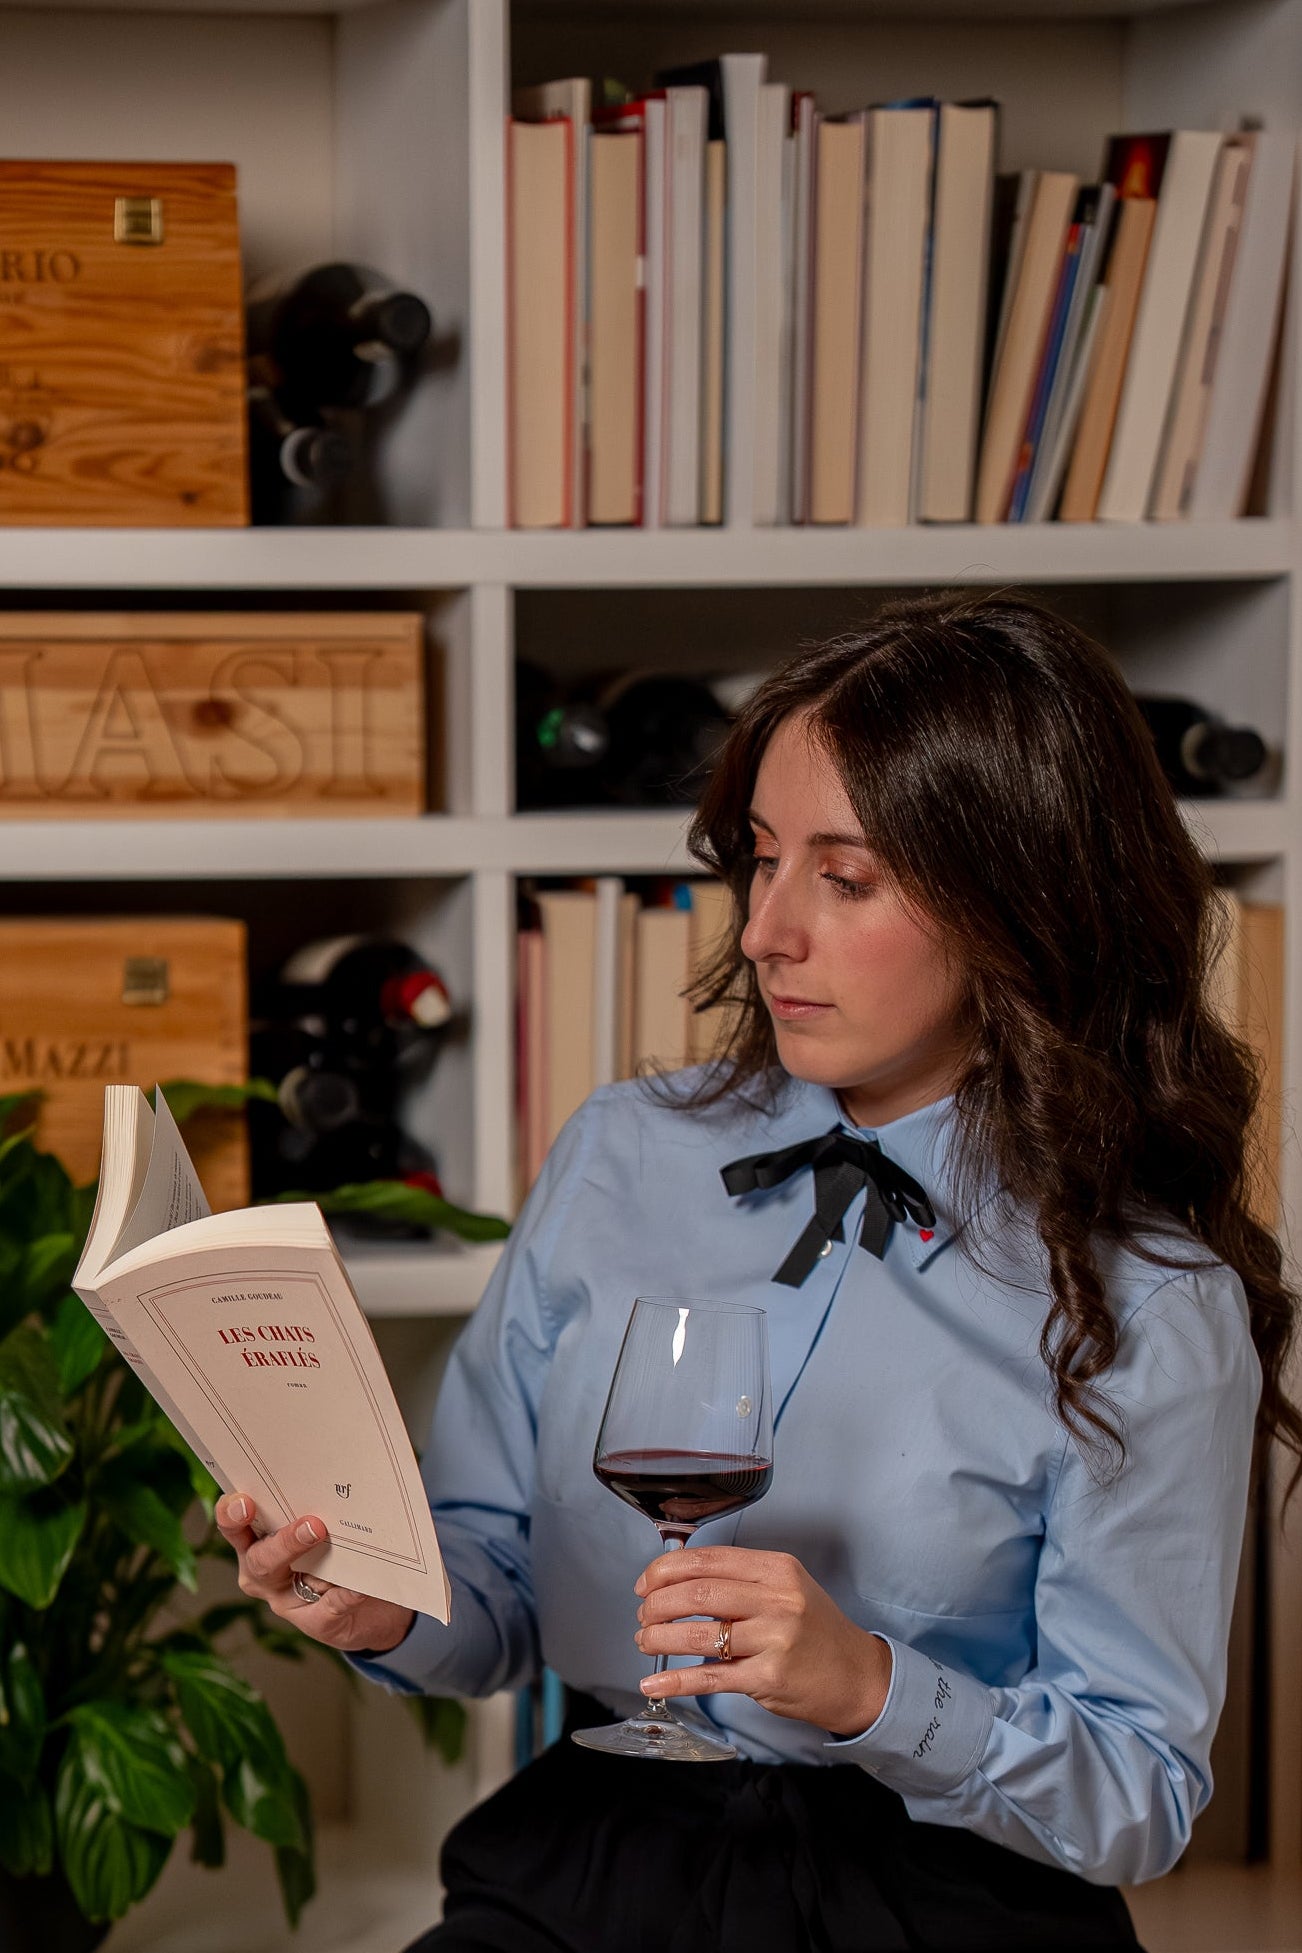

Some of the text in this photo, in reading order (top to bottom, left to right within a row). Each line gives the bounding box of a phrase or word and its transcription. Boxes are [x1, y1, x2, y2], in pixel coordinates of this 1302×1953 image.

[3, 1036, 130, 1079] MAZZI
[211, 1292, 283, 1304] CAMILLE GOUDEAU
[217, 1325, 315, 1345] LES CHATS
[241, 1347, 320, 1369] ÉRAFLÉS
[334, 1483, 352, 1499] nrf
[340, 1519, 373, 1534] GALLIMARD
[934, 1676, 952, 1709] the
[913, 1716, 941, 1759] rain
